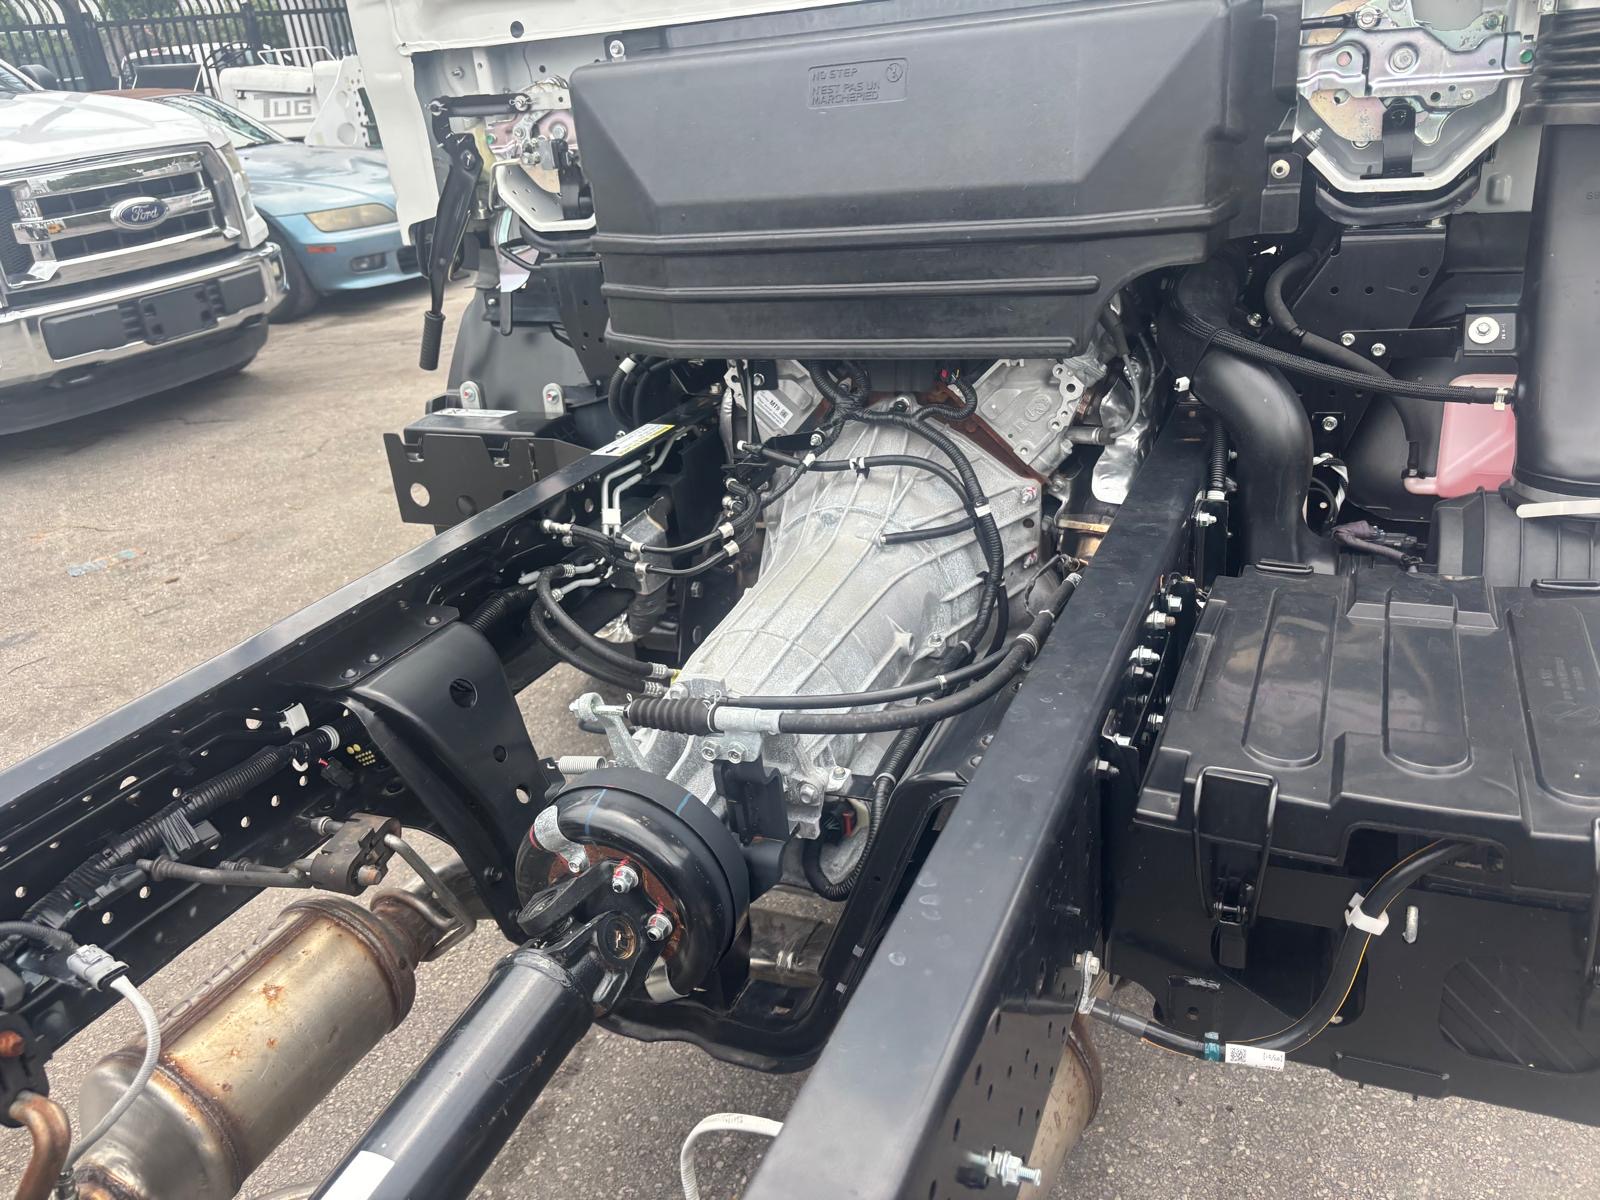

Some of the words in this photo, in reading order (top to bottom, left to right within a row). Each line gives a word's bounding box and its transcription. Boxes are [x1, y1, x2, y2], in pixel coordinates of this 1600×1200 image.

[829, 68, 858, 79] STEP
[254, 93, 312, 118] TUG
[131, 204, 159, 222] Ford
